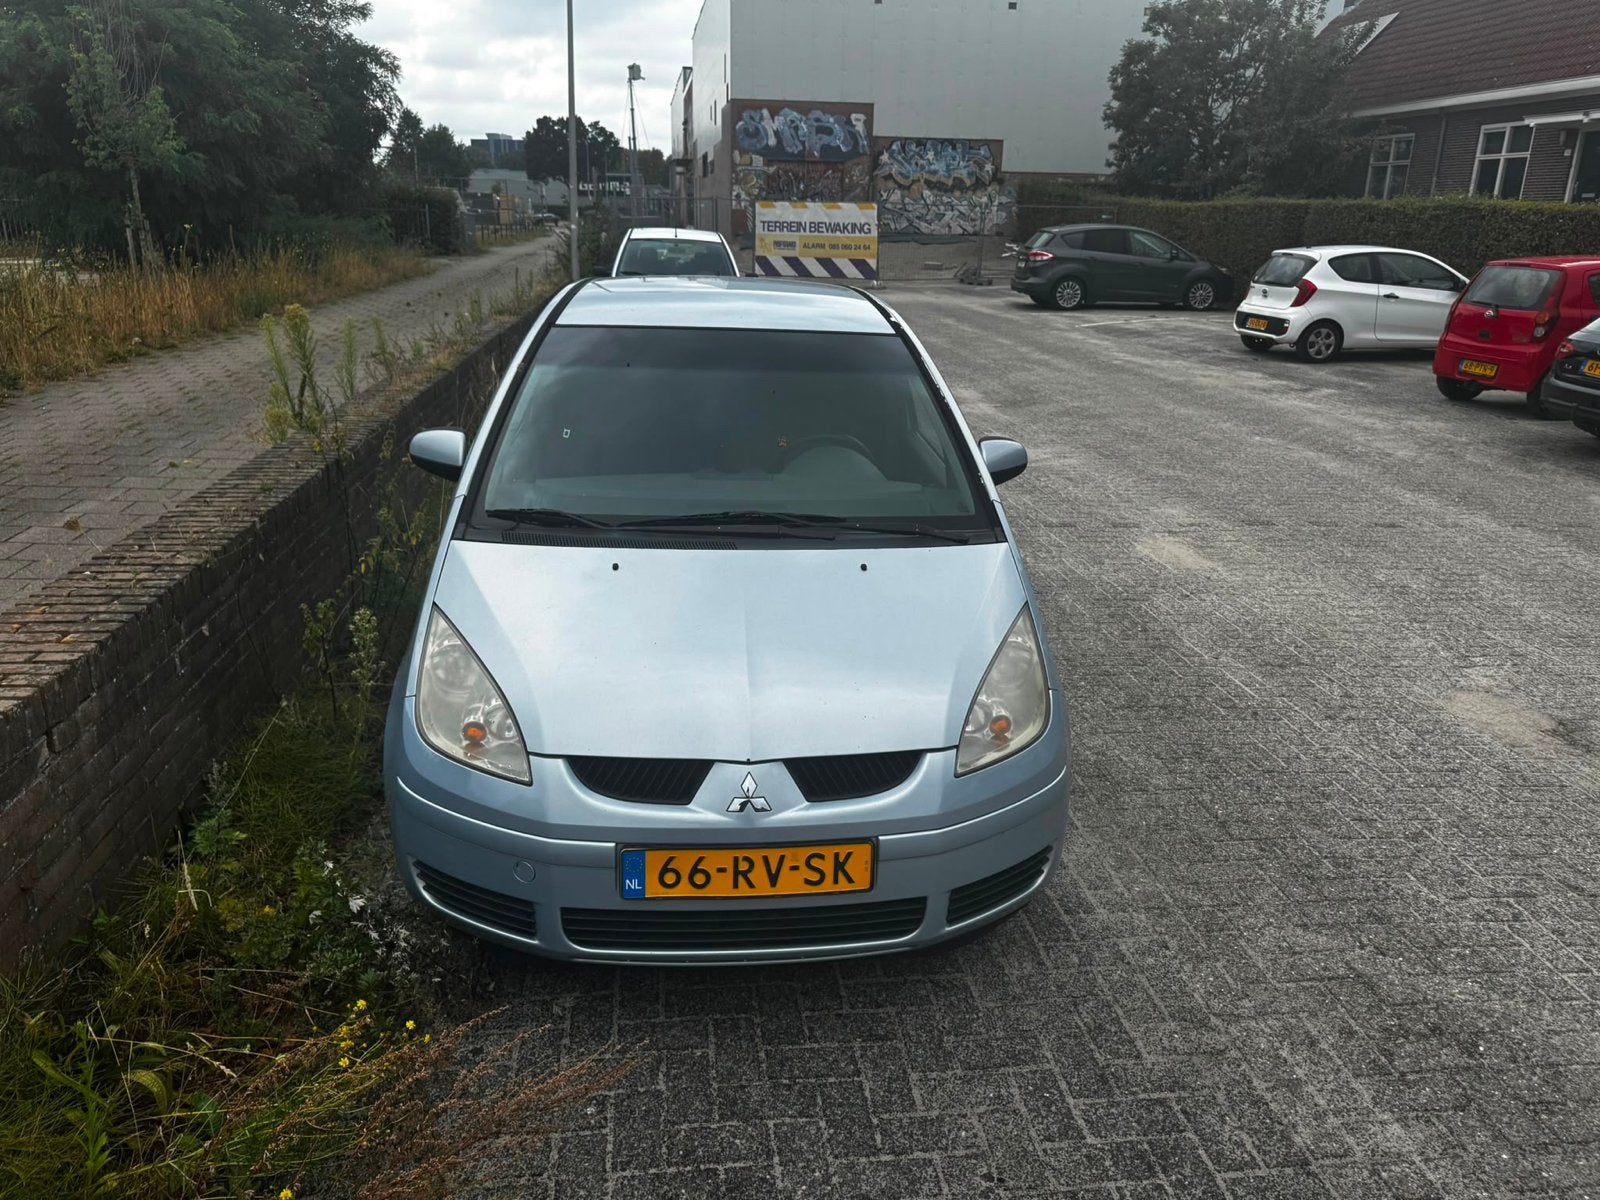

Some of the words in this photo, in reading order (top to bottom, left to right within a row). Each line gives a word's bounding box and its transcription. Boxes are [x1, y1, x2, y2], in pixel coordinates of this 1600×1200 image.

[760, 220, 807, 233] TERREIN
[809, 221, 871, 235] BEWAKING
[625, 879, 642, 890] NL
[658, 851, 856, 890] 66-RV-SK
